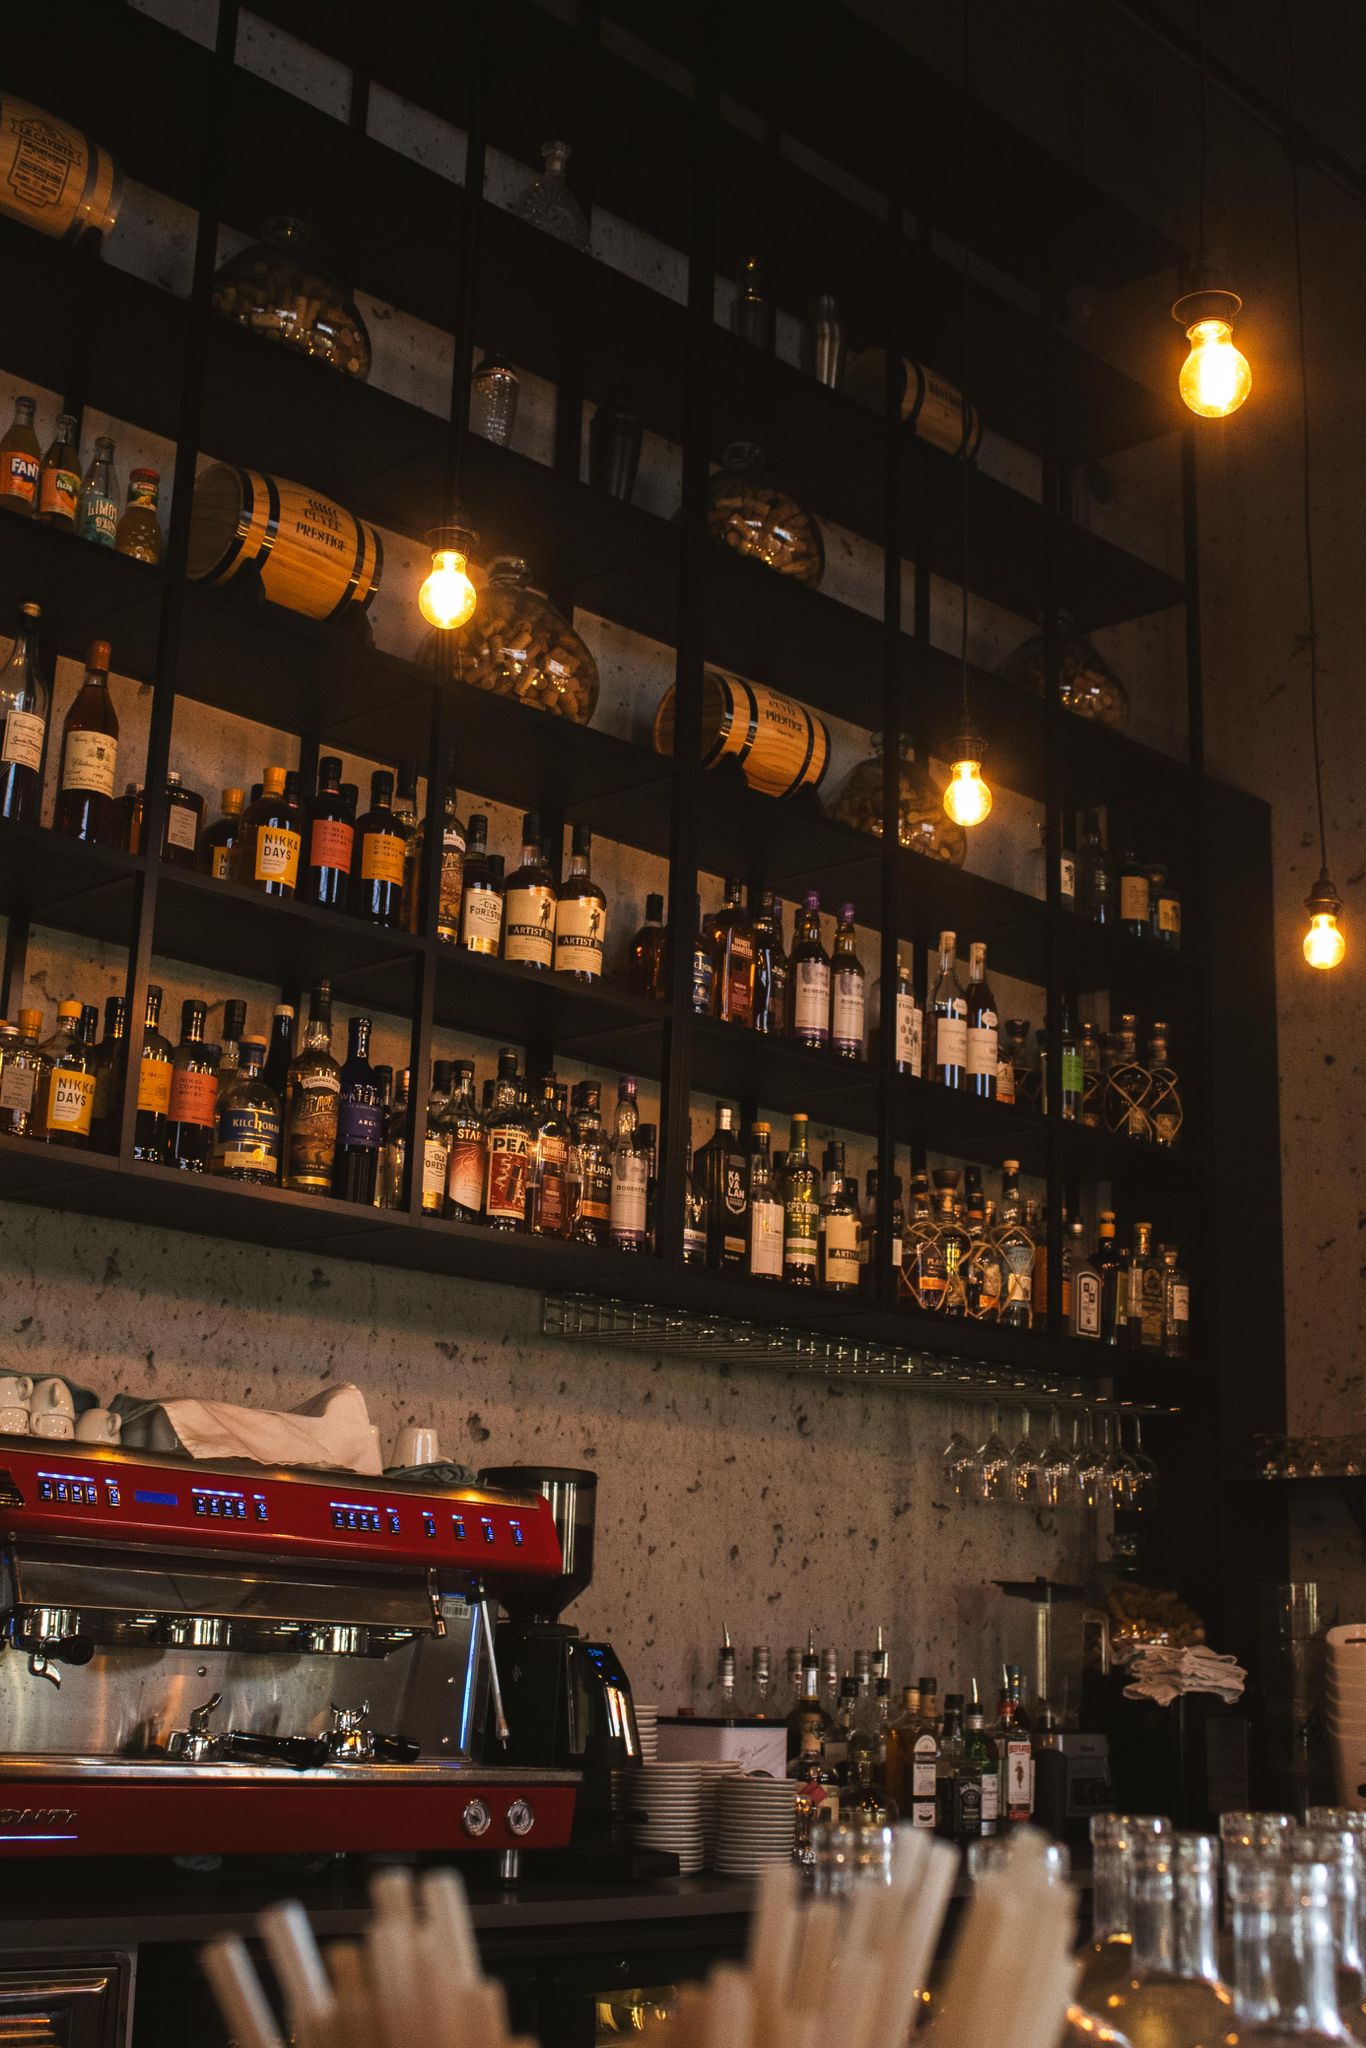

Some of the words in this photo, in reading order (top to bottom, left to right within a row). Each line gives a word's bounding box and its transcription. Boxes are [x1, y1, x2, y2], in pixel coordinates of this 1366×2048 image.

[296, 521, 347, 553] PRESTIGE
[263, 845, 292, 861] DAYS
[513, 926, 543, 937] ARTIST
[563, 936, 592, 947] ARTIST
[56, 1090, 87, 1107] DAYS
[492, 1137, 529, 1155] PEA
[586, 1165, 612, 1177] JURA
[596, 1179, 603, 1188] 12
[728, 1187, 745, 1200] LAN
